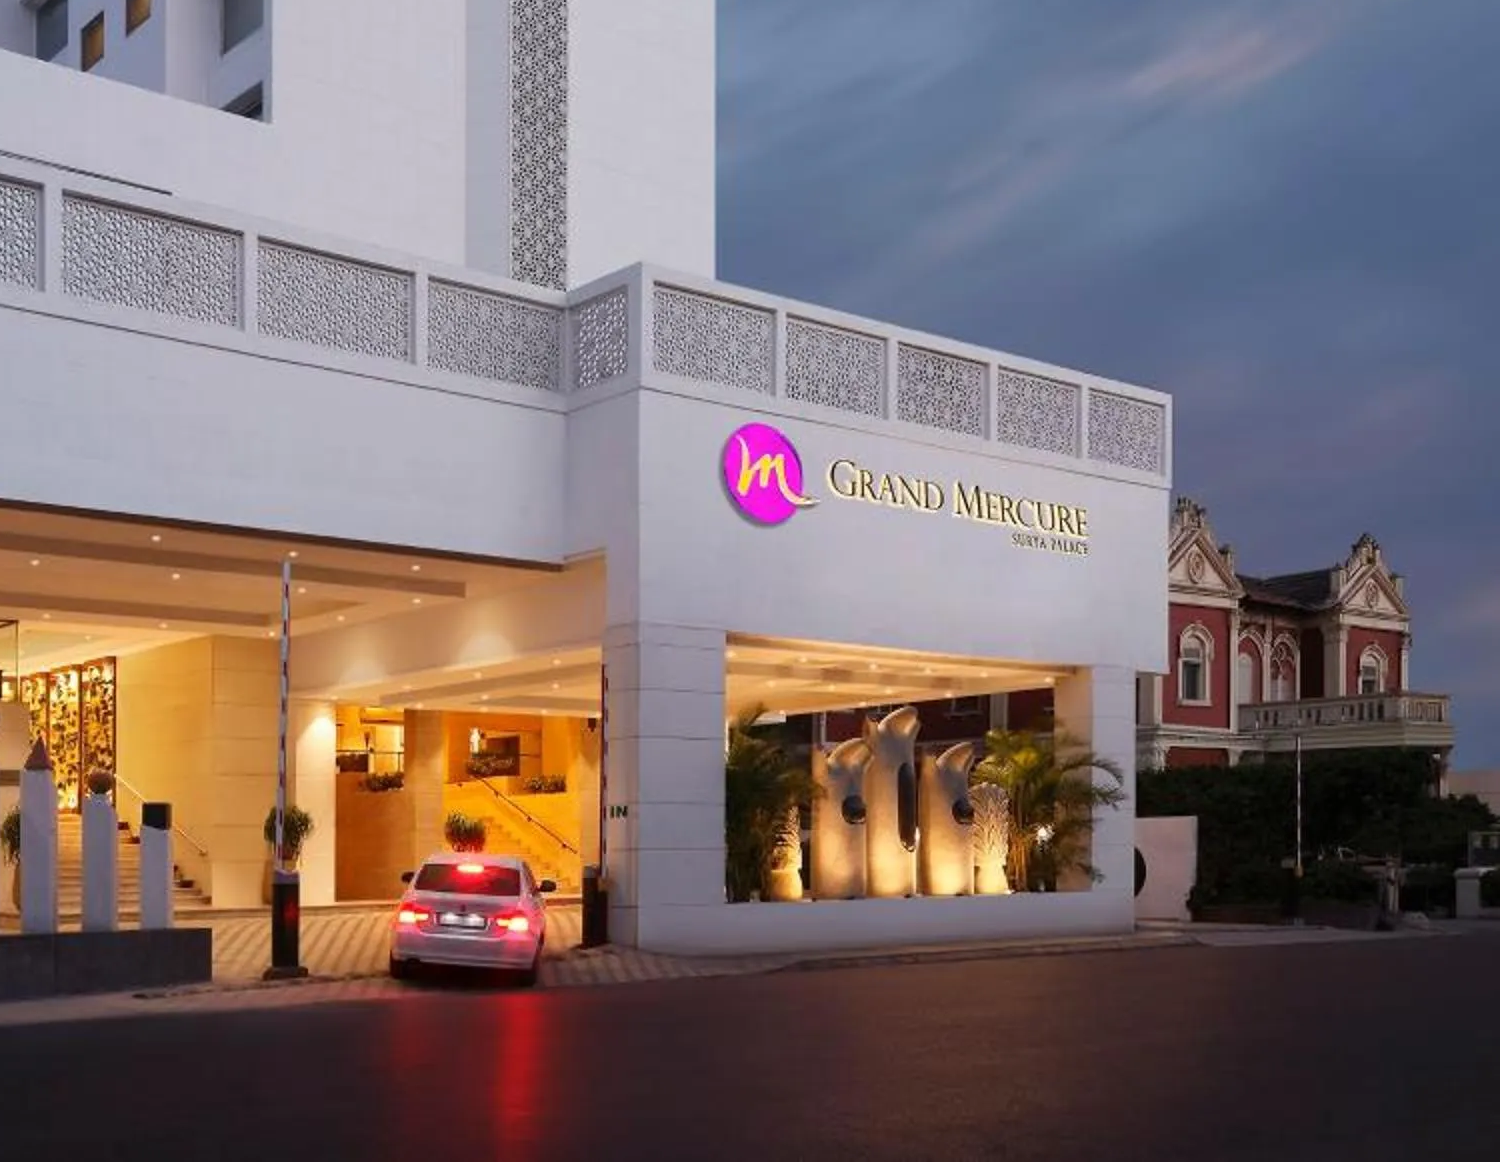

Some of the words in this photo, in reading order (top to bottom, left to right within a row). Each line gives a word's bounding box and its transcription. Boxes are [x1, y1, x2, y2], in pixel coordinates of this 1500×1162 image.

[827, 458, 945, 512] GRAND
[951, 480, 1091, 539] MERCURE
[609, 805, 628, 819] IN
